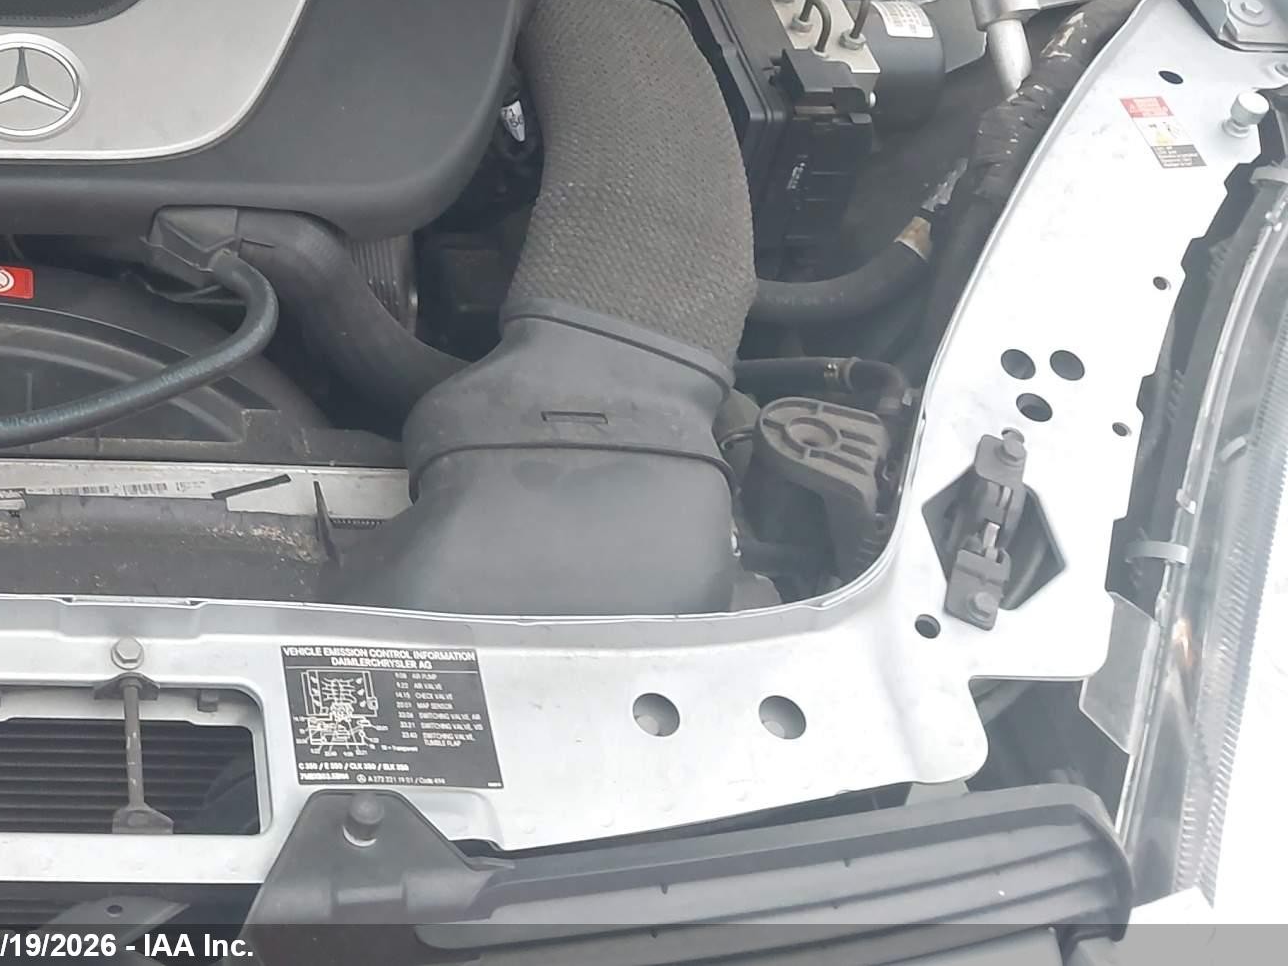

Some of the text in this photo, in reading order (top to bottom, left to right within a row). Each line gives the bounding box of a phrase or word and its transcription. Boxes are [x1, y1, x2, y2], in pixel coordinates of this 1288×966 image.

[283, 647, 476, 661] VEHICLE EMISSION CONTROL INFORMATION
[332, 657, 433, 670] DAIMLERCHRYSLER AG
